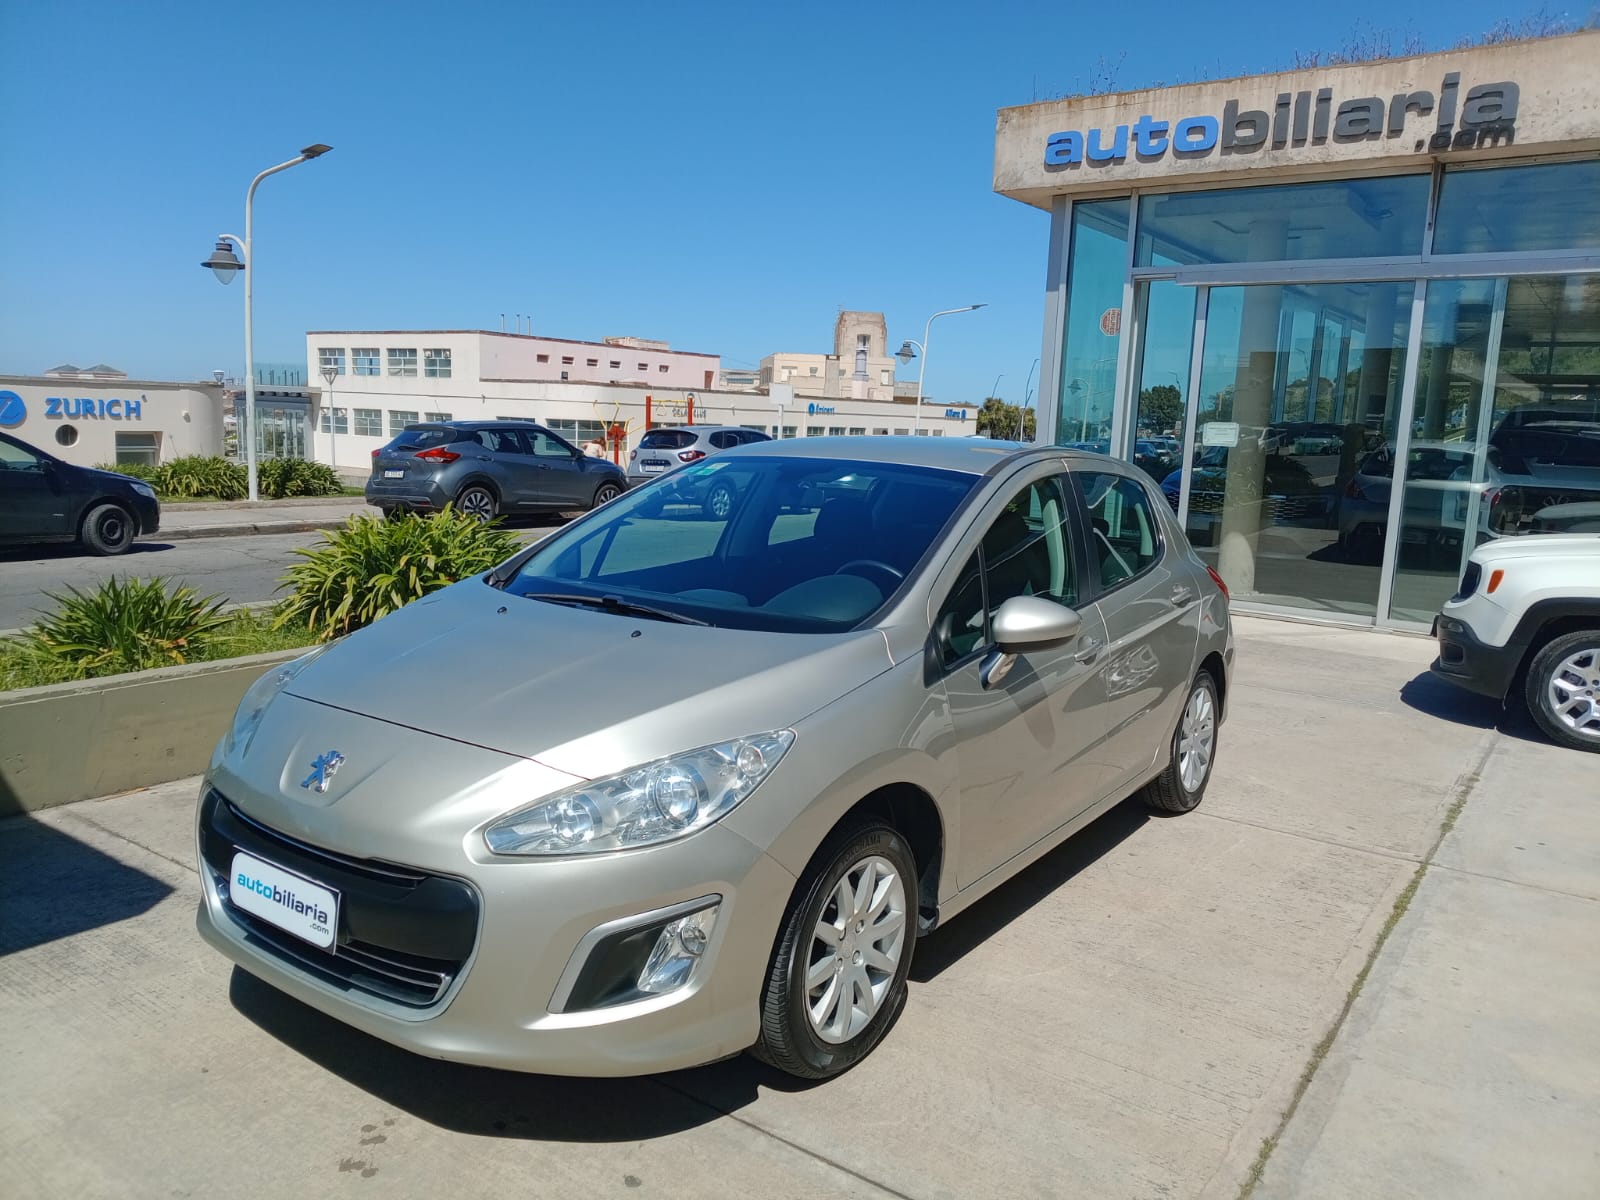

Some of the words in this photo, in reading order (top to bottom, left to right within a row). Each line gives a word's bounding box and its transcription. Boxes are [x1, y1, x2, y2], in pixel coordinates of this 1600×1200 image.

[1044, 71, 1520, 167] autobiliaria
[44, 397, 142, 418] ZURICH
[237, 872, 328, 925] autobiliaria
[309, 923, 329, 935] .com
